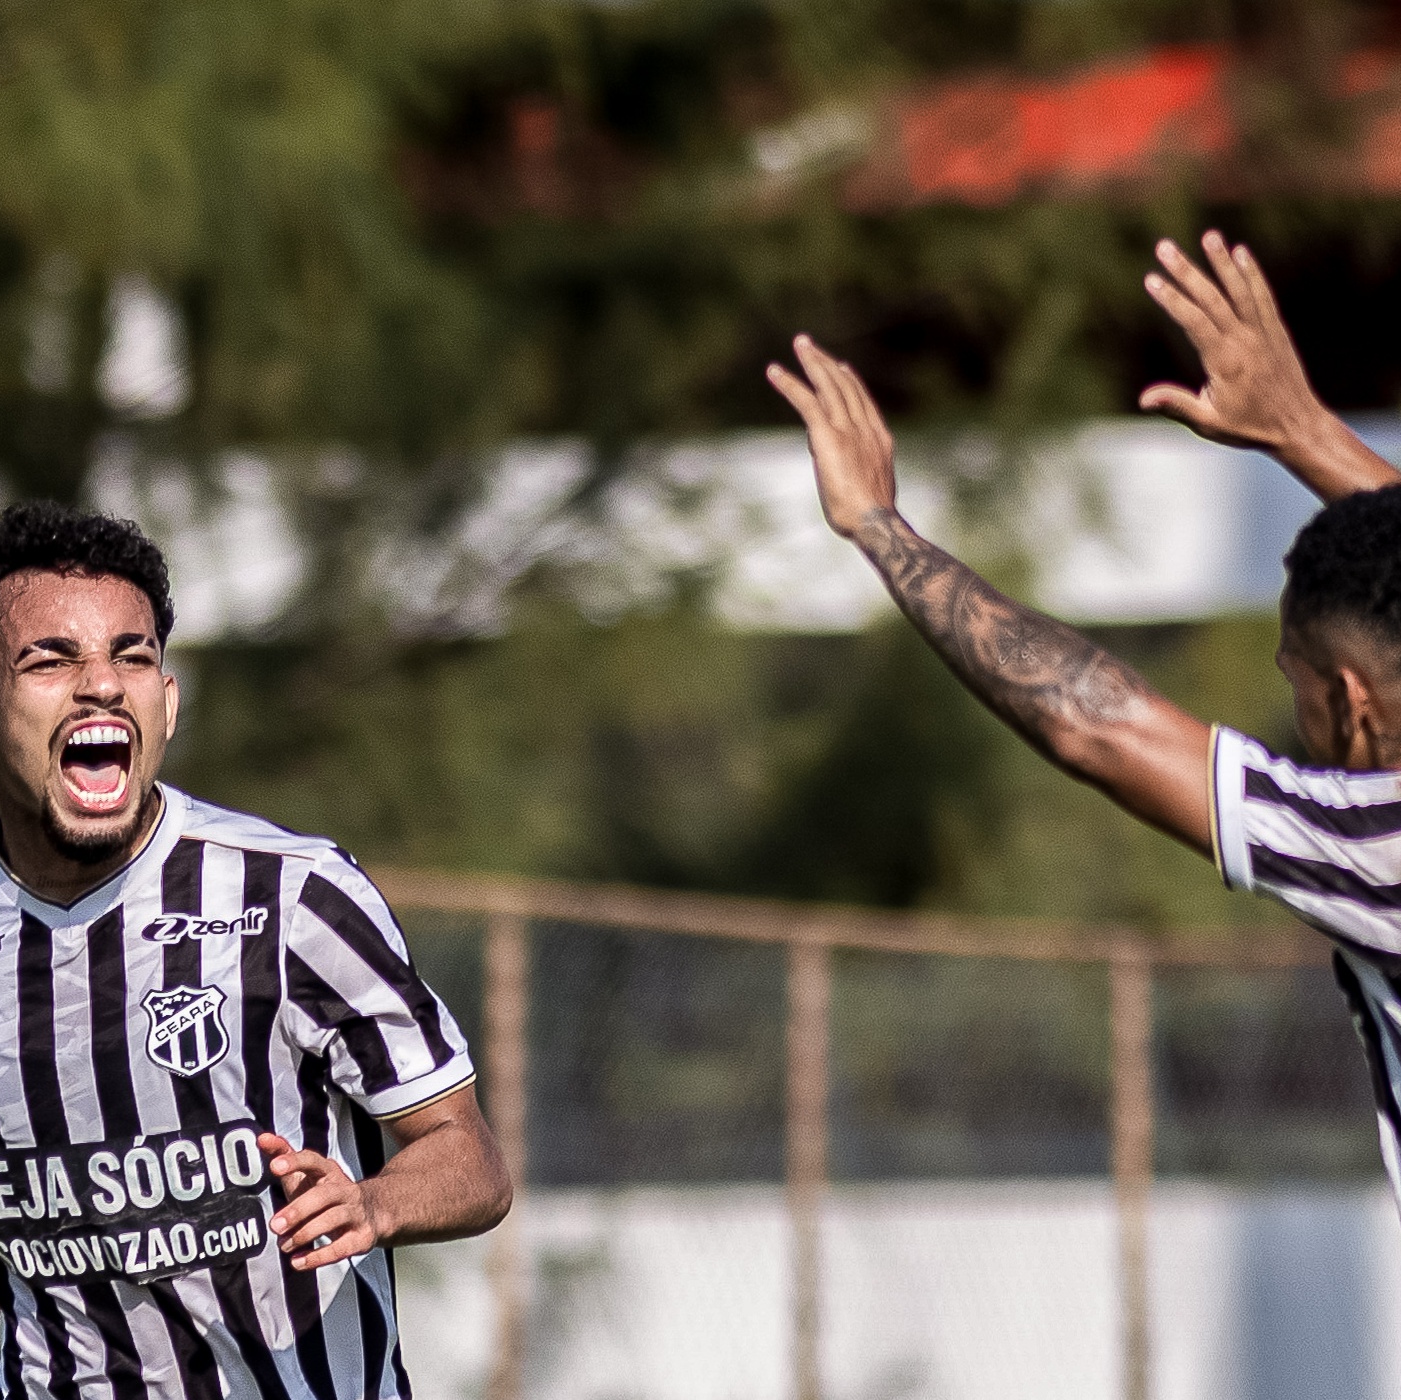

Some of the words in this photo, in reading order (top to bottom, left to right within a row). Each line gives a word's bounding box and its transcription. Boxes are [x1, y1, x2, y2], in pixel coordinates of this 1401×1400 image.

[191, 909, 264, 936] zenir
[155, 995, 216, 1042] CEARÁ
[87, 1127, 263, 1216] SÓCIO
